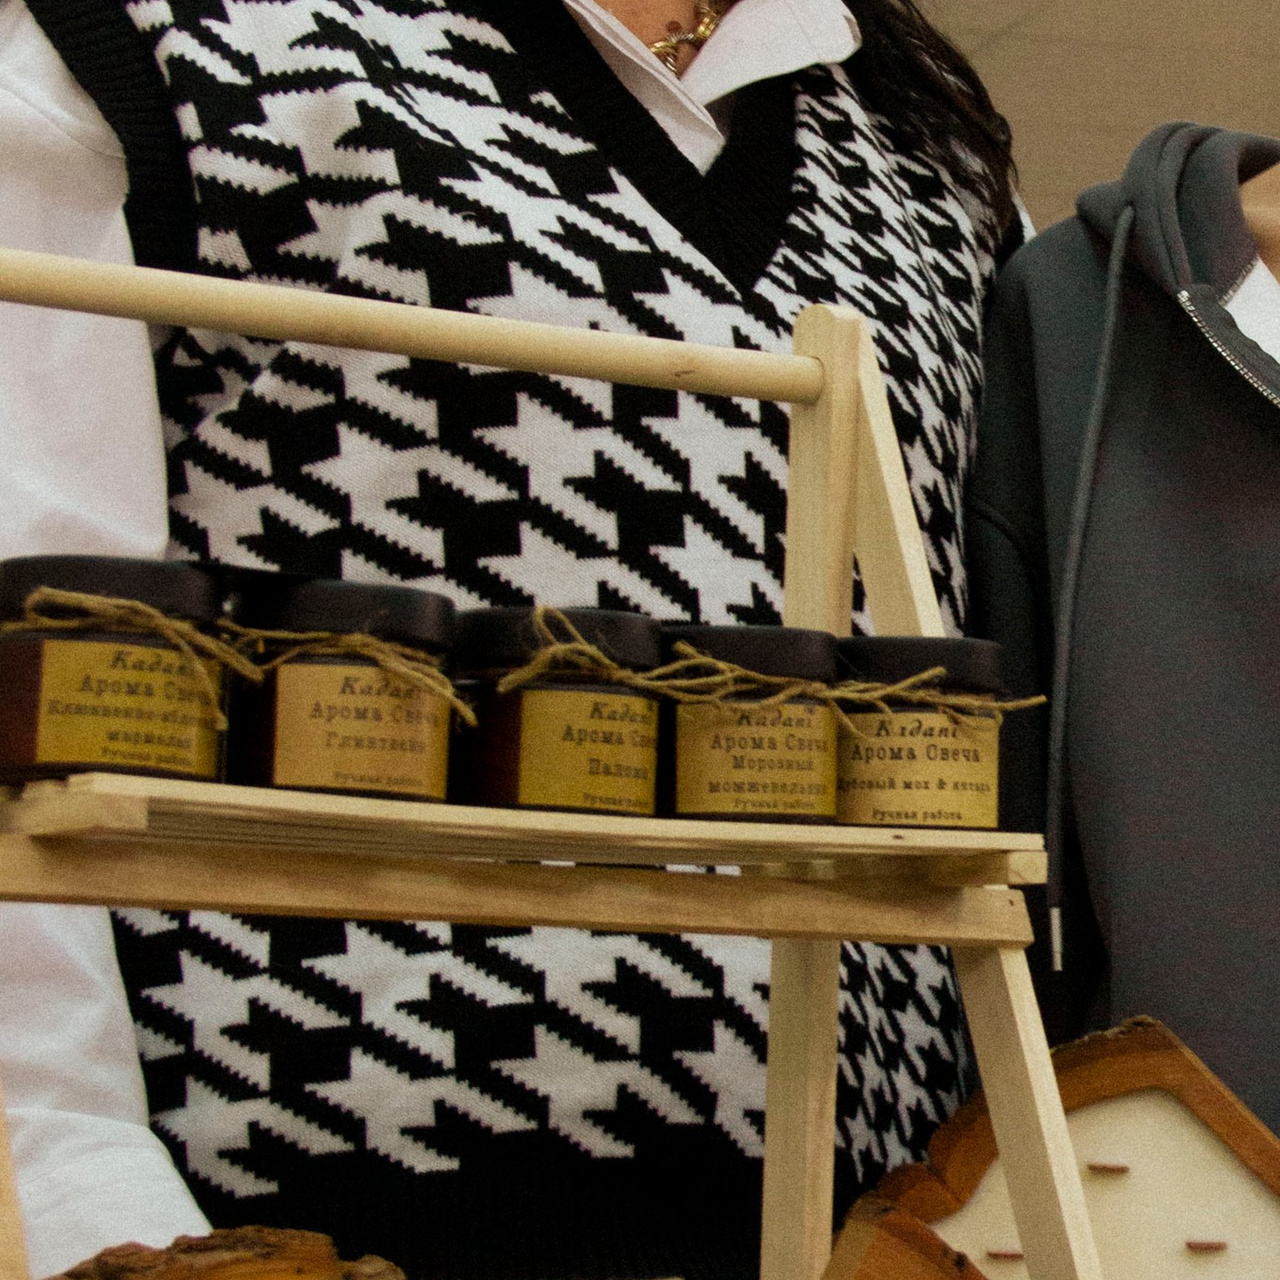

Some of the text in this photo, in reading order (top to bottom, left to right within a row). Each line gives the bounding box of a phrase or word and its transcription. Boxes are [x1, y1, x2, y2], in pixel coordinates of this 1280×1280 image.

[711, 733, 778, 753] Арома
[851, 743, 981, 764] Арома Свеча
